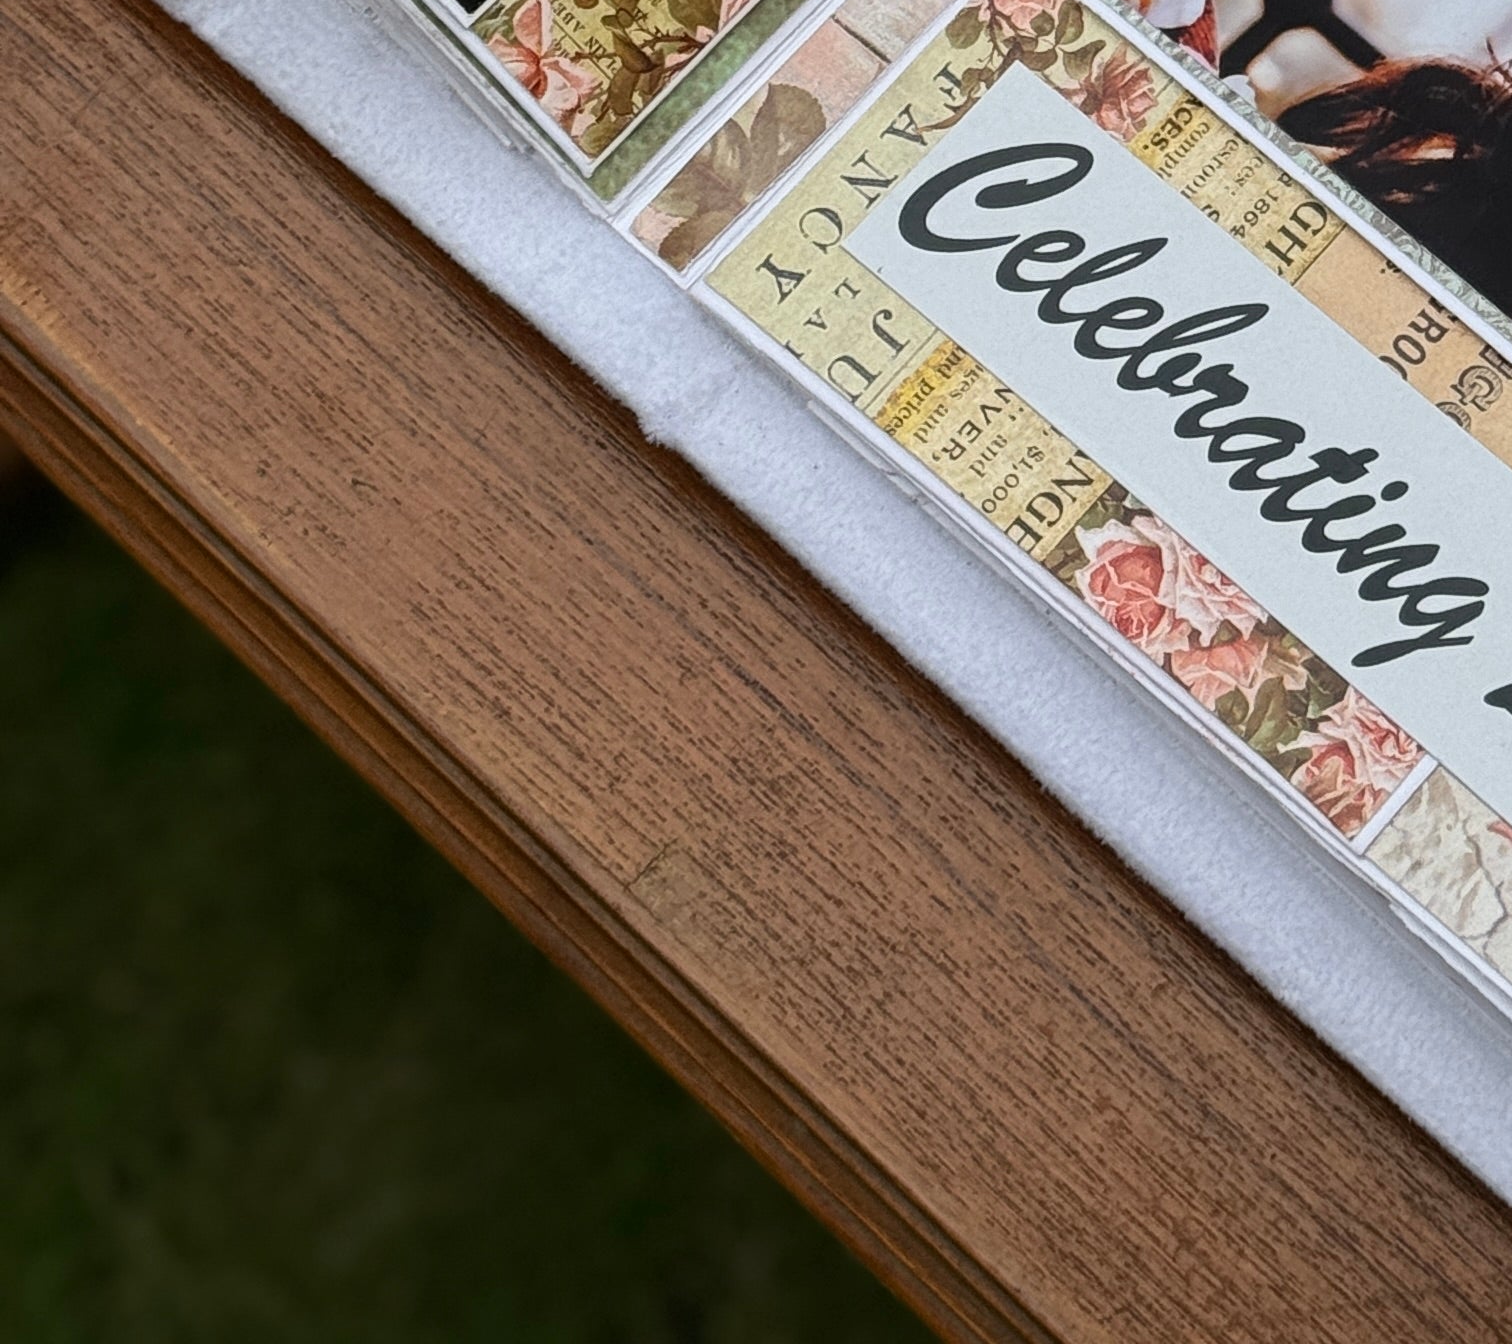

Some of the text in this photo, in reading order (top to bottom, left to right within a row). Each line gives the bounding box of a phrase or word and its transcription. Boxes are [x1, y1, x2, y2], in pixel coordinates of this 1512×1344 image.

[755, 61, 982, 305] FANCY
[898, 142, 1489, 667] Celebrating
[912, 403, 949, 444] and
[968, 434, 1008, 479] and
